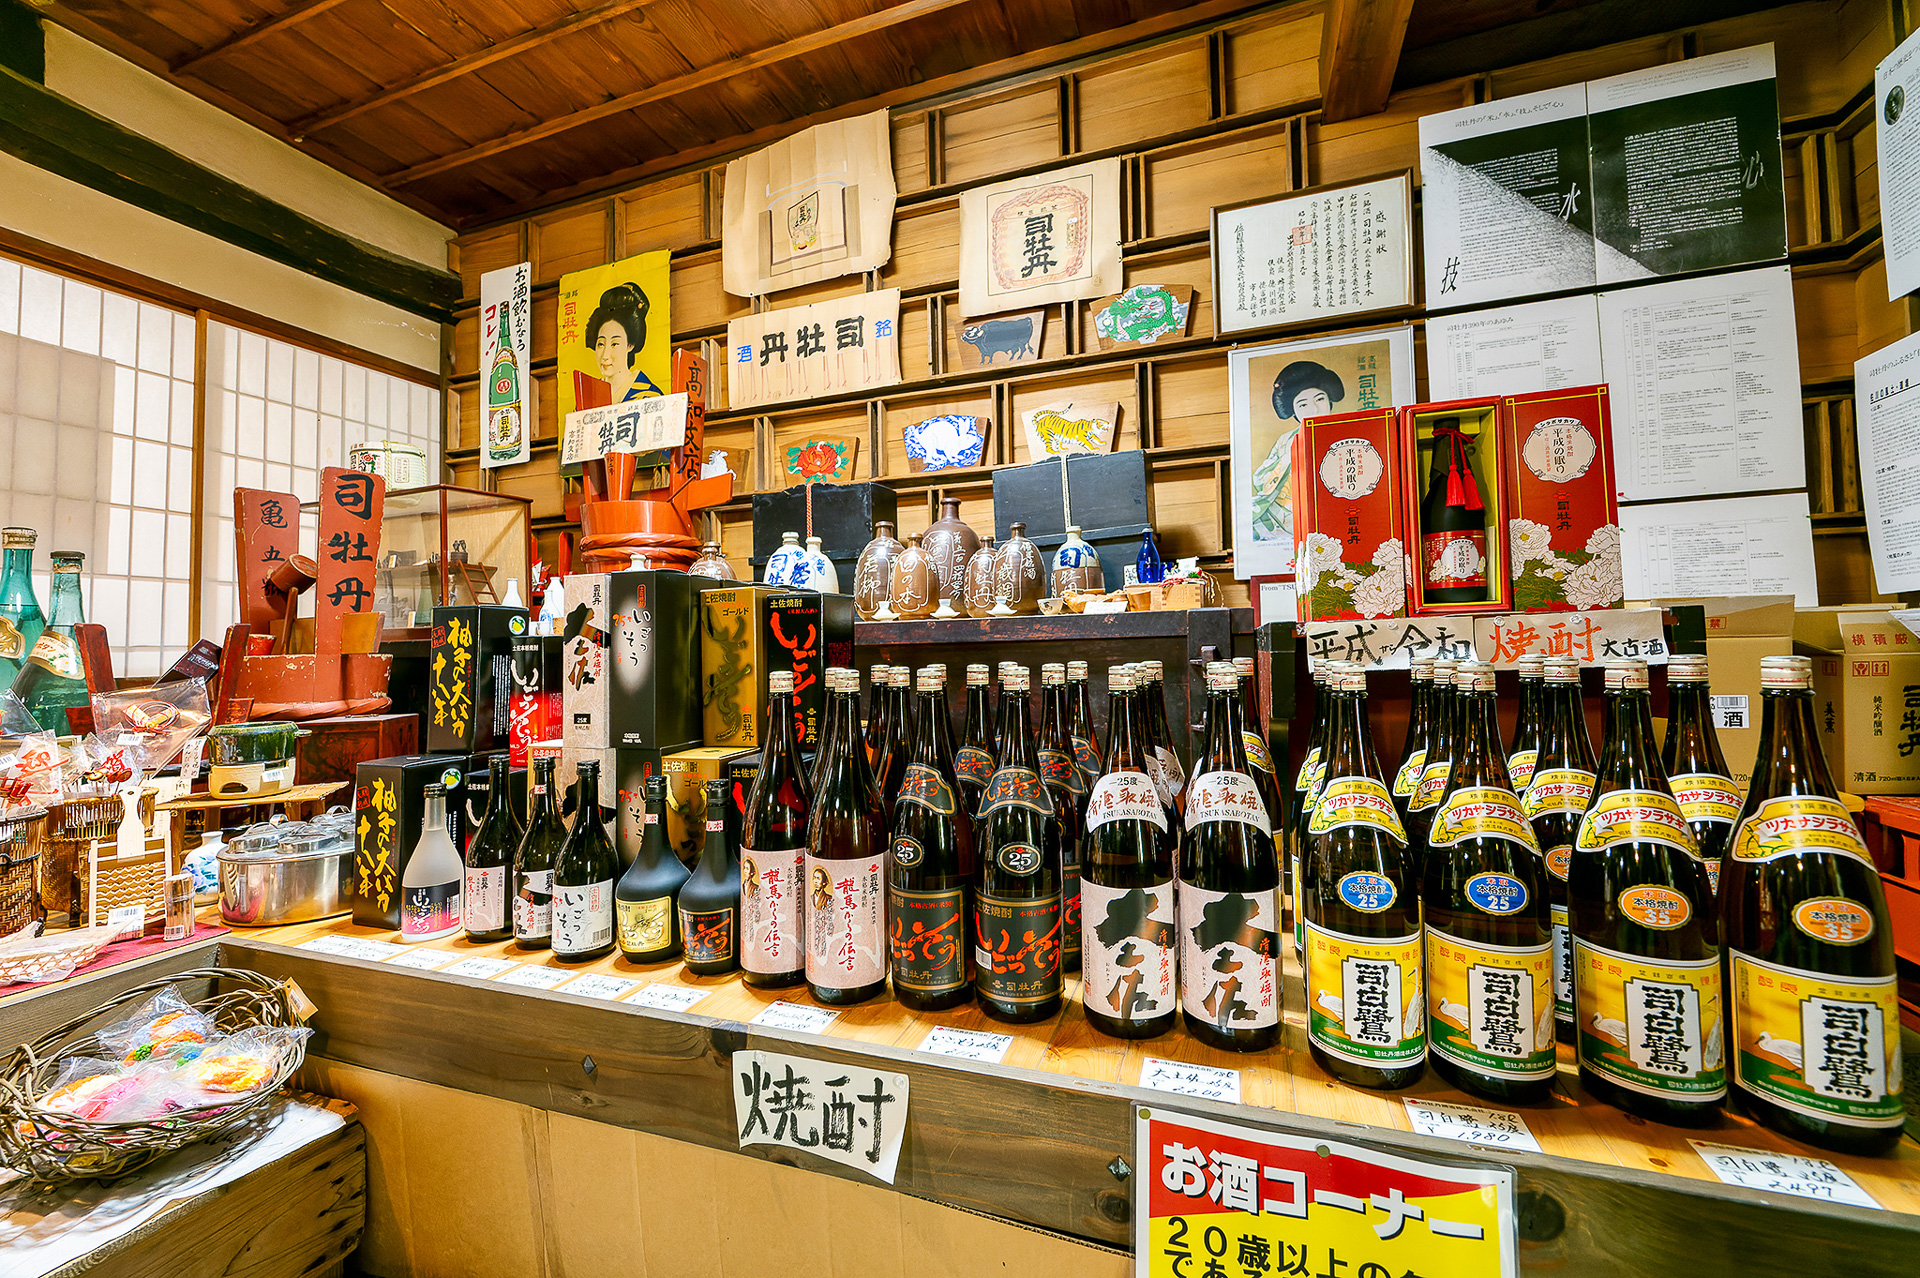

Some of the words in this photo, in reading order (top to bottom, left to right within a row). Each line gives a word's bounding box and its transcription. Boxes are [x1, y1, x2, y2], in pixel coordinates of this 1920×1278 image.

[1558, 182, 1581, 221] 水
[1021, 213, 1057, 279] 司牡丹
[1375, 210, 1388, 254] 感謝状
[1441, 256, 1461, 295] 技
[511, 266, 528, 352] お酒飲むなら
[562, 301, 579, 345] 司牡丹
[1553, 428, 1566, 474] 平成の眠り
[1345, 449, 1357, 491] 平成の眠り
[1556, 501, 1572, 531] 司牡丹
[326, 473, 375, 613] 司牡丹
[1347, 517, 1361, 545] 司牡丹
[722, 608, 750, 617] ゴールド
[770, 598, 803, 609] 土佐焼酎
[1489, 617, 1602, 663] 焼酎
[1601, 637, 1665, 658] 大古酒
[431, 651, 451, 728] 十八年
[447, 616, 473, 739] 柚子の大バカ
[741, 713, 754, 742] 司牡丹
[1723, 711, 1744, 727] 酒
[1873, 695, 1883, 736] 純米吟醸酒
[805, 717, 818, 744] 司牡丹
[662, 762, 698, 773] 土佐焼酎
[1117, 776, 1138, 786] 25度
[1216, 775, 1239, 786] 25度
[1853, 772, 1877, 782] 清酒
[1103, 808, 1157, 820] TSUKASABOTAN
[1200, 808, 1260, 822] TSUKASABOTAN
[1328, 795, 1394, 815] ツカサシラサギ
[1452, 804, 1526, 824] ツカサシラサギ
[1601, 808, 1684, 830] ツカサシラサギ
[1765, 815, 1858, 837] ツカサシラサギ
[356, 814, 376, 899] 十八年
[371, 776, 397, 914] 柚子の大バカ
[897, 845, 914, 860] 25
[1009, 852, 1032, 866] 25
[869, 873, 881, 896] 司牡丹
[1349, 882, 1386, 894] 本格焼酎
[1477, 884, 1519, 896] 本格焼酎
[761, 867, 785, 959] 龍馬からの伝言
[1358, 893, 1378, 907] 25
[1488, 895, 1510, 910] 25
[1632, 897, 1679, 910] 本格焼酎
[556, 892, 584, 947] いごっそう
[835, 876, 860, 972] 龍馬からの伝言
[1644, 909, 1671, 924] 35
[1809, 910, 1862, 924] 本格焼酎
[976, 911, 1062, 979] いごっそう
[1824, 923, 1855, 940] 35
[901, 968, 932, 980] 司牡丹
[1006, 980, 1044, 991] 司牡丹
[1354, 963, 1394, 1044] 司白鷺
[1480, 970, 1526, 1056] 司白鷺
[1640, 985, 1692, 1074] 司白鷺
[1818, 1004, 1876, 1098] 司白鷺
[740, 1060, 896, 1163] 焼酎
[1161, 1141, 1485, 1241] お酒コーナー
